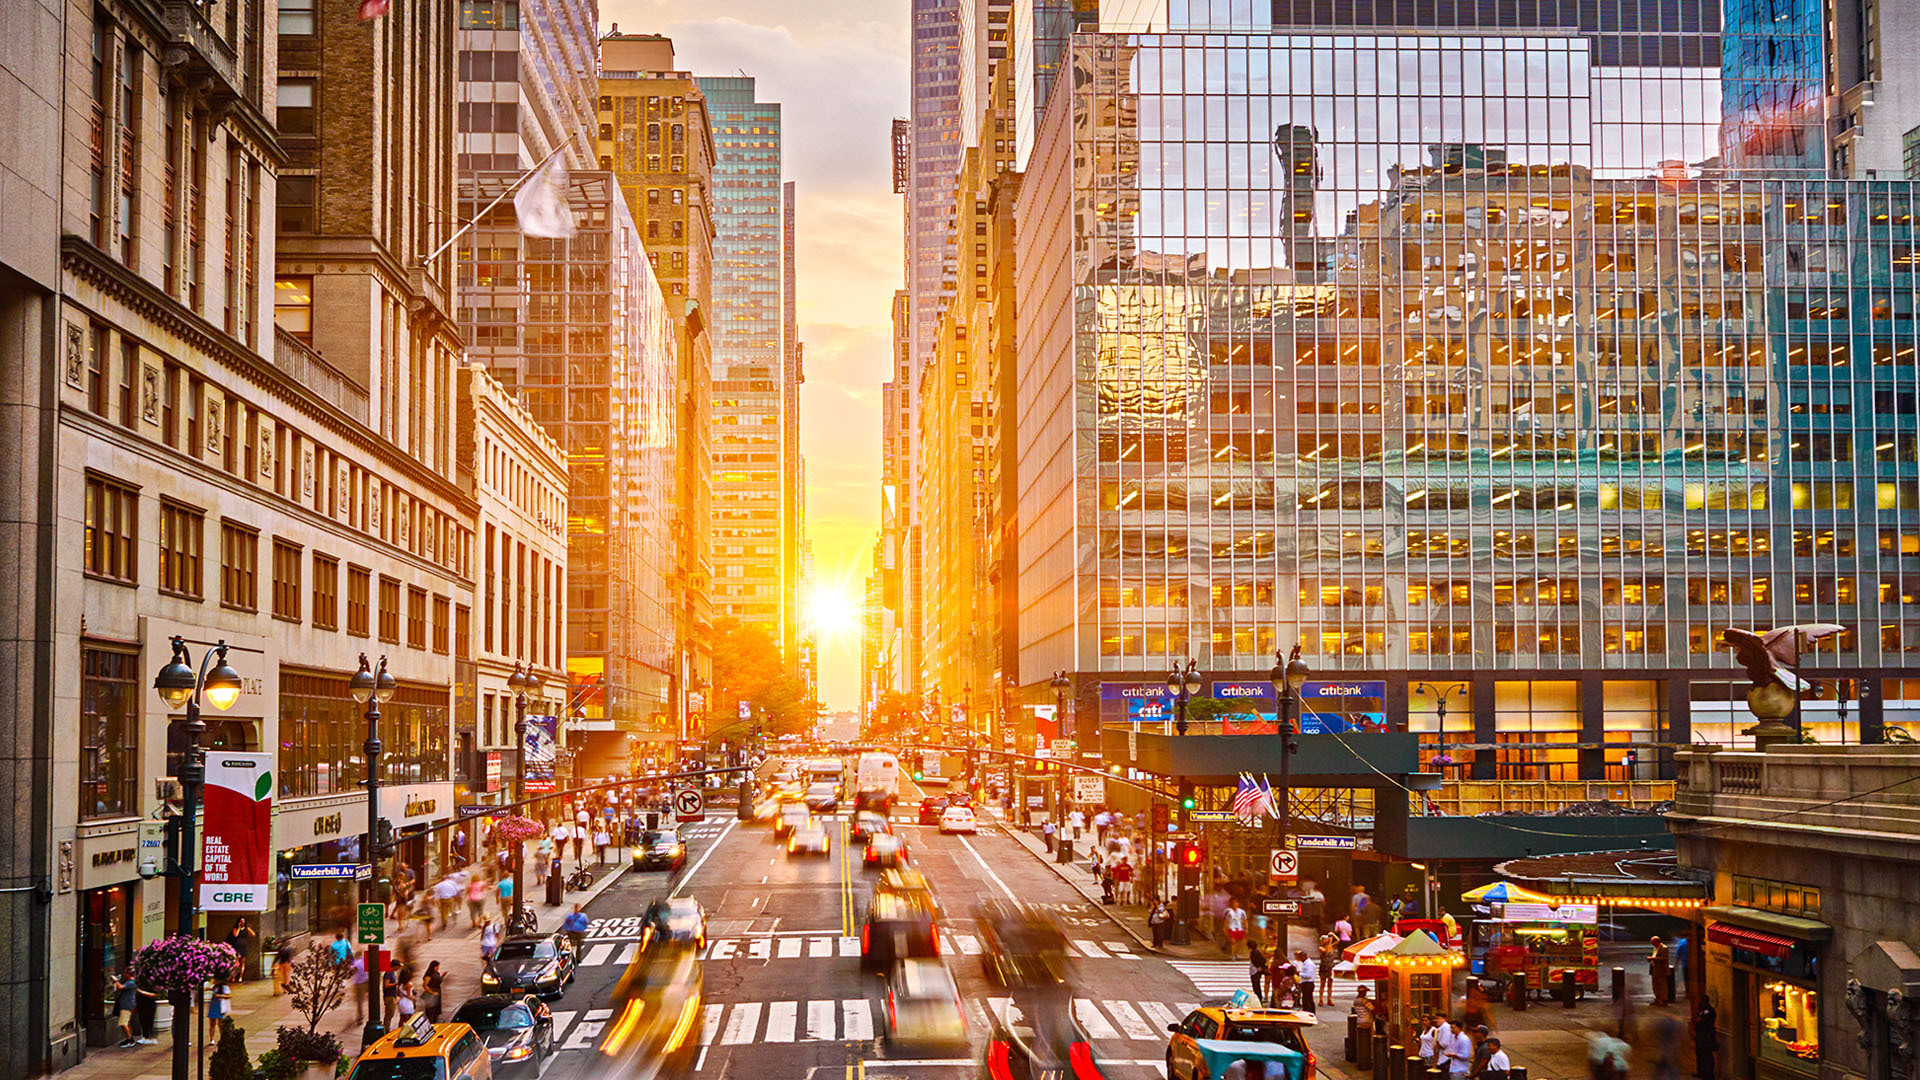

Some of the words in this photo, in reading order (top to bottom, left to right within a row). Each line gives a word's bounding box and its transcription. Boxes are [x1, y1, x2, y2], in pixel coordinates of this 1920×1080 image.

[1122, 685, 1165, 697] citibank
[1221, 685, 1263, 696] citibank
[1319, 684, 1362, 695] citibank
[1138, 703, 1165, 717] citi
[205, 836, 222, 844] REAL
[1297, 838, 1338, 847] Vanderbilt
[1339, 839, 1355, 847] Ave
[205, 845, 229, 854] ESTATE
[205, 854, 232, 863] CAPITAL
[205, 863, 214, 872] OF
[215, 863, 228, 872] THE
[293, 866, 340, 876] Vanderbilt
[341, 866, 355, 875] Av
[204, 872, 229, 881] WORLD
[213, 892, 254, 903] CBRE
[588, 916, 642, 928] BUS
[583, 926, 641, 938] ONL
